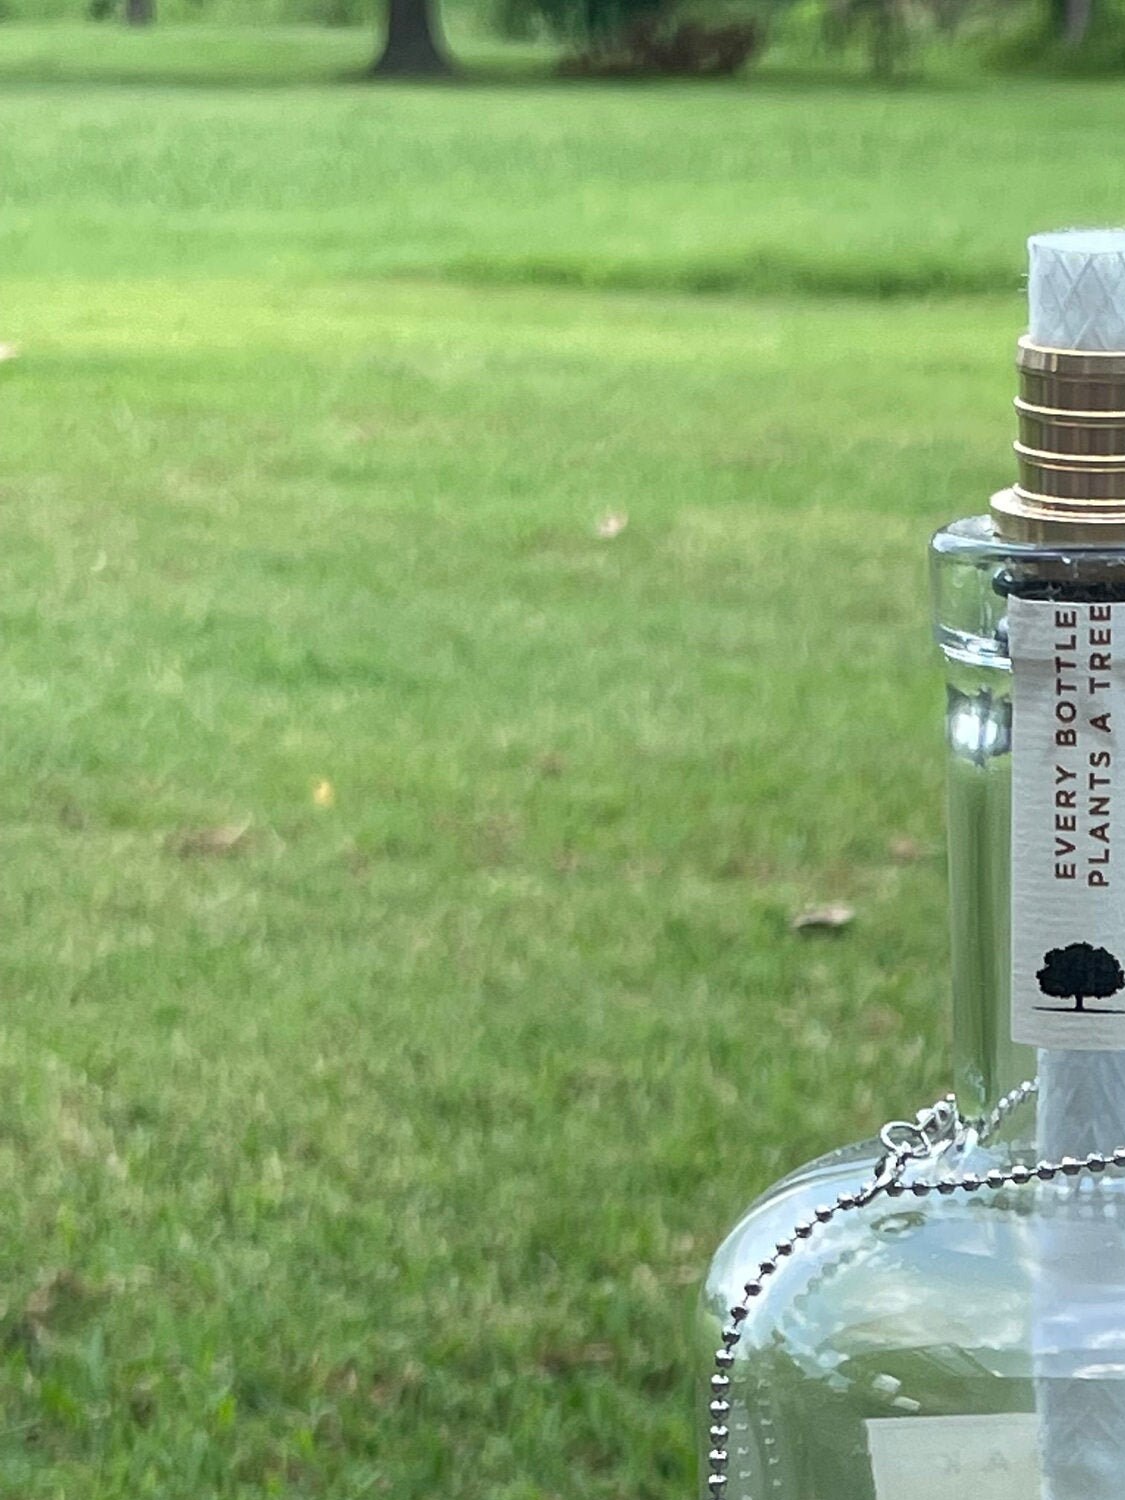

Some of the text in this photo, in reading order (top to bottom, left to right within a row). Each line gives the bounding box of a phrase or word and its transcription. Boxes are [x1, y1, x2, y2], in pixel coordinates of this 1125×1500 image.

[1054, 611, 1077, 879] EVERY BOTTLE
[1088, 606, 1112, 887] PLANTS A TREE
